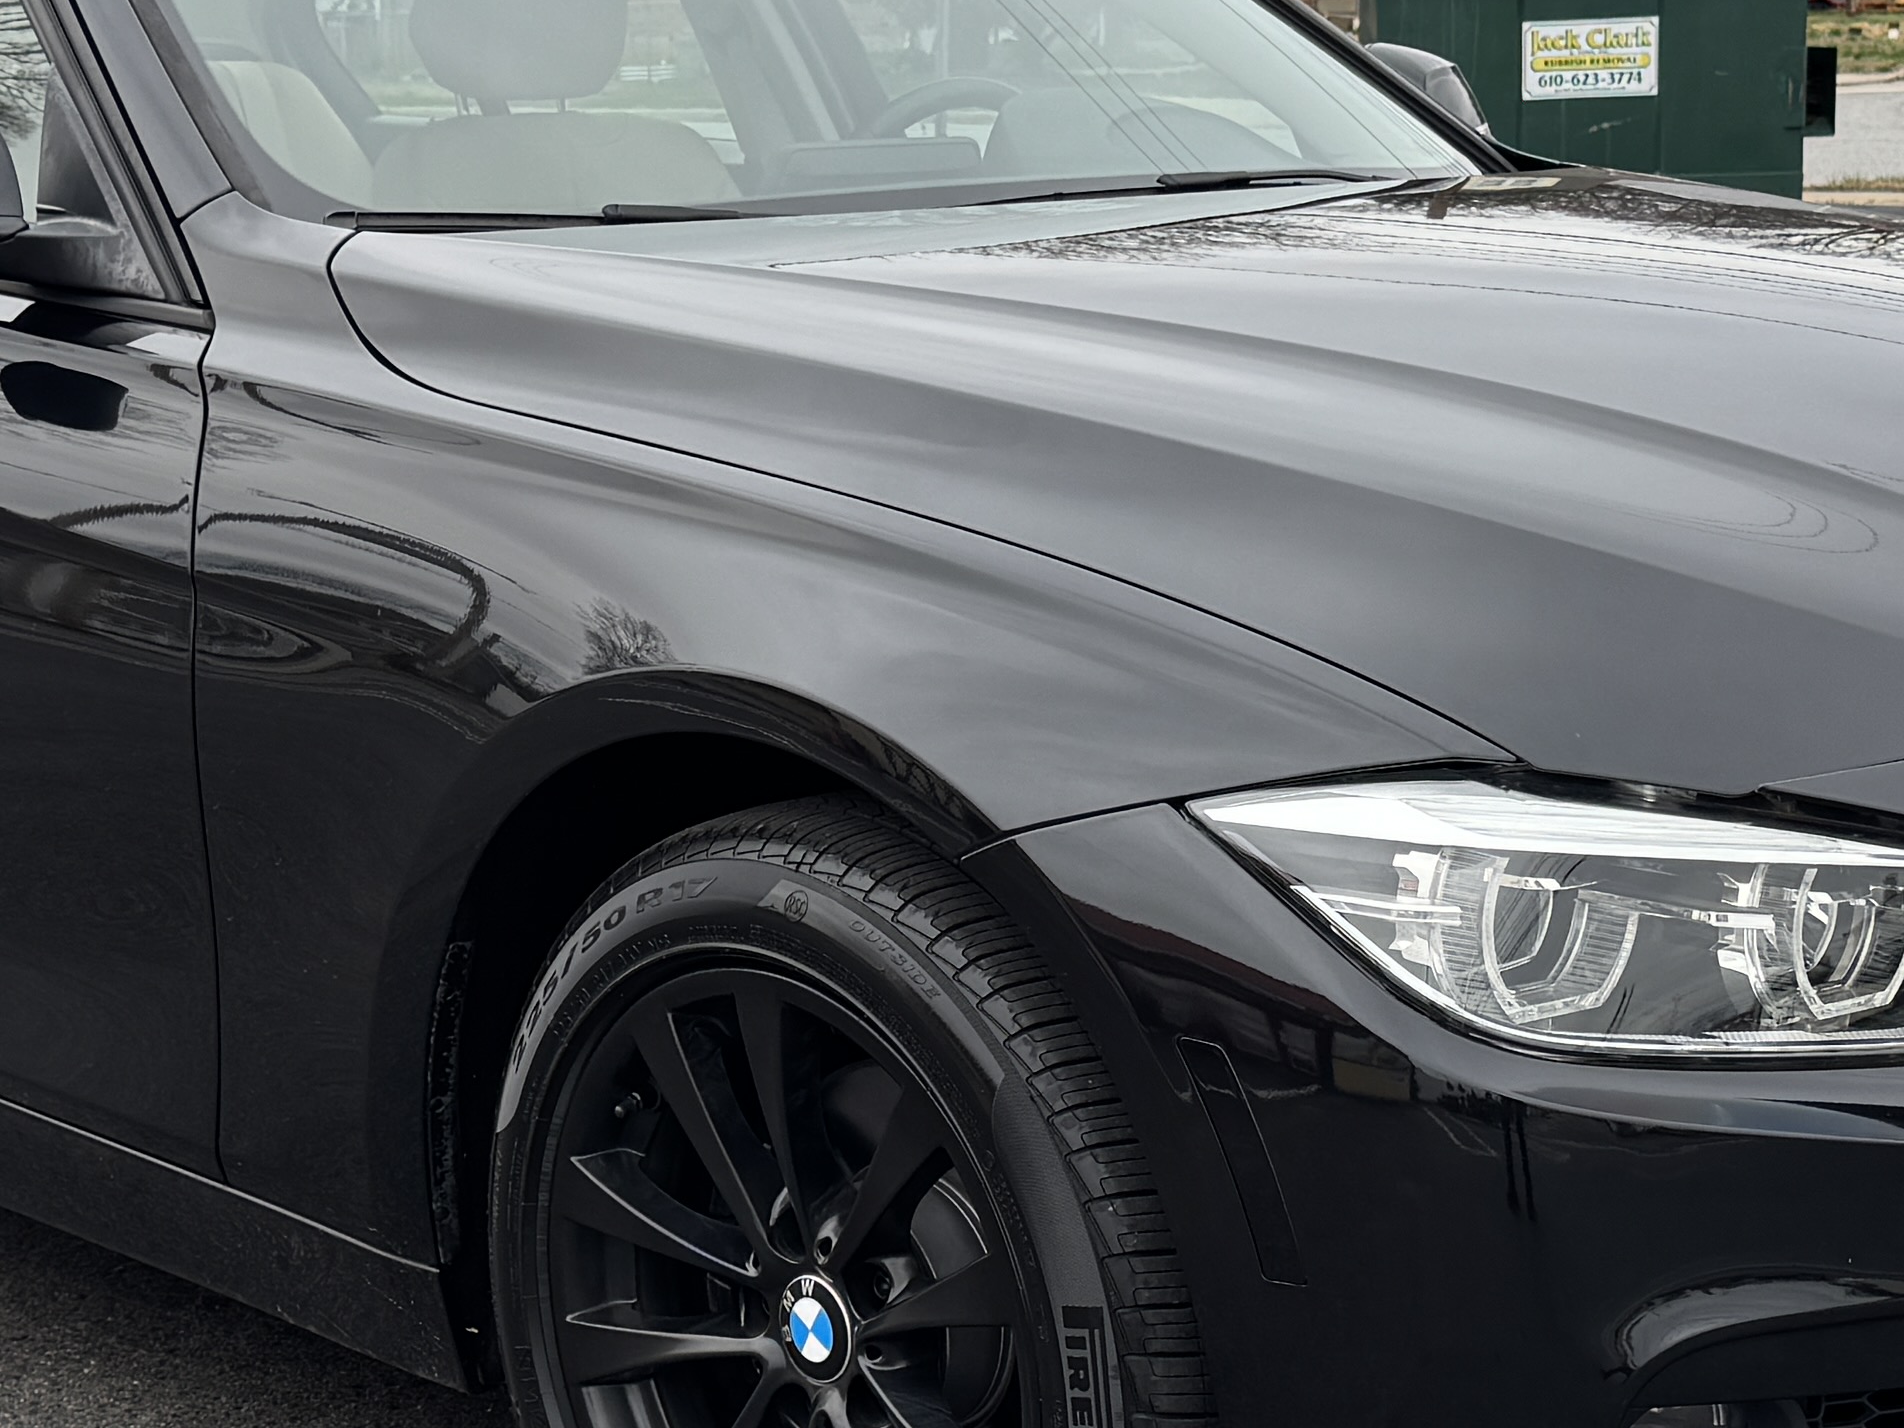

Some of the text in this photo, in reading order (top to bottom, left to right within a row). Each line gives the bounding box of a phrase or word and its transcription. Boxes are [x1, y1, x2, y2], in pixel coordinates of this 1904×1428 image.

[1530, 26, 1652, 57] Jack Clark
[1543, 56, 1637, 67] RUBBISH REMOVAL
[1538, 71, 1642, 88] 610-623-3774
[512, 904, 628, 1074] 225/50
[635, 875, 718, 915] R17
[848, 918, 942, 1001] OUTSIDE
[782, 1277, 816, 1343] BMW
